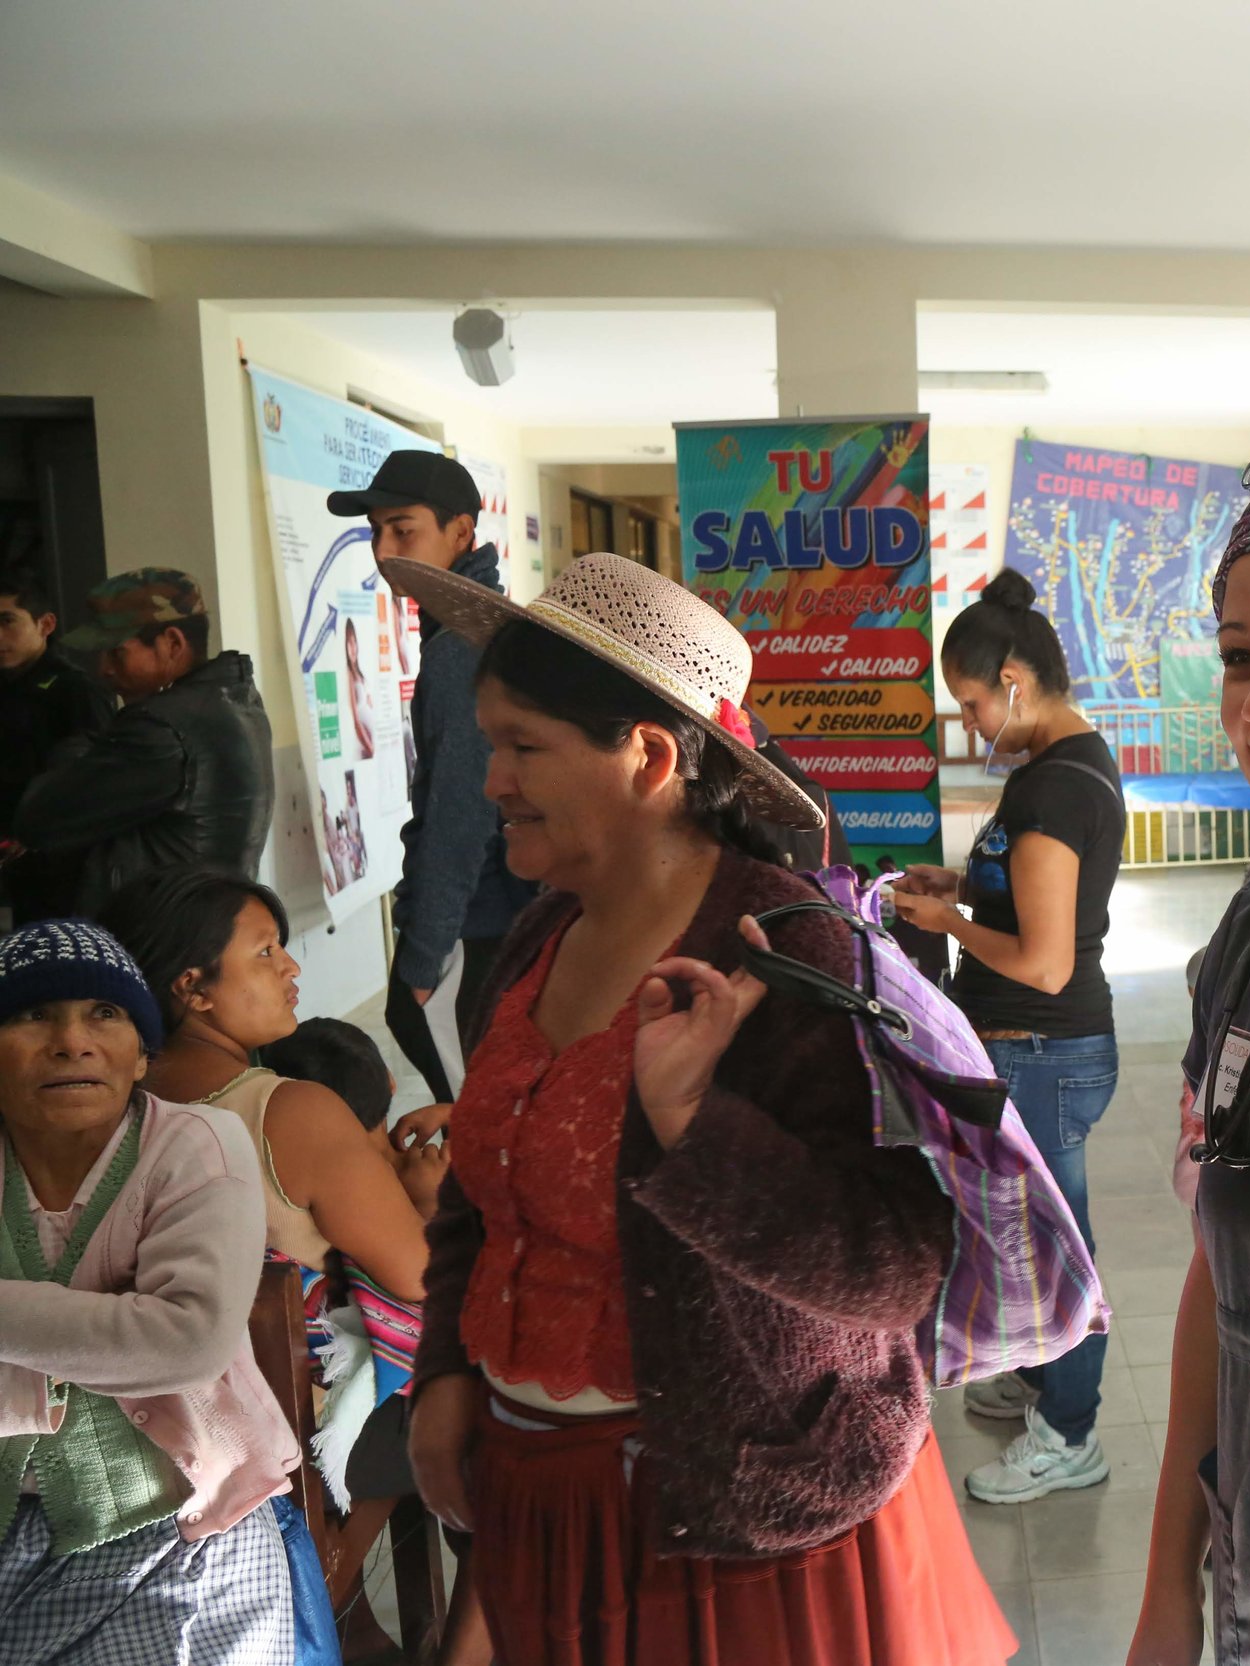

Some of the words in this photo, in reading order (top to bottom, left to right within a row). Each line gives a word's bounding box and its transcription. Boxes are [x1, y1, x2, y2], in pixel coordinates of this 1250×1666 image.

[767, 449, 833, 493] TU
[1065, 452, 1146, 480] MAPEO
[1166, 464, 1196, 487] DE
[1036, 473, 1180, 510] COBERTURA
[691, 506, 923, 572] SALUD
[738, 588, 787, 616] UN
[795, 584, 930, 617] DERECHO
[769, 635, 848, 654] CALIDEZ
[839, 656, 919, 676] CALIDAD
[779, 688, 883, 708] VERACIDAD
[817, 713, 923, 732] SEGURIDAD
[792, 756, 937, 774] ONFIDENCIALIDAD
[837, 811, 935, 830] NSABILIDAD
